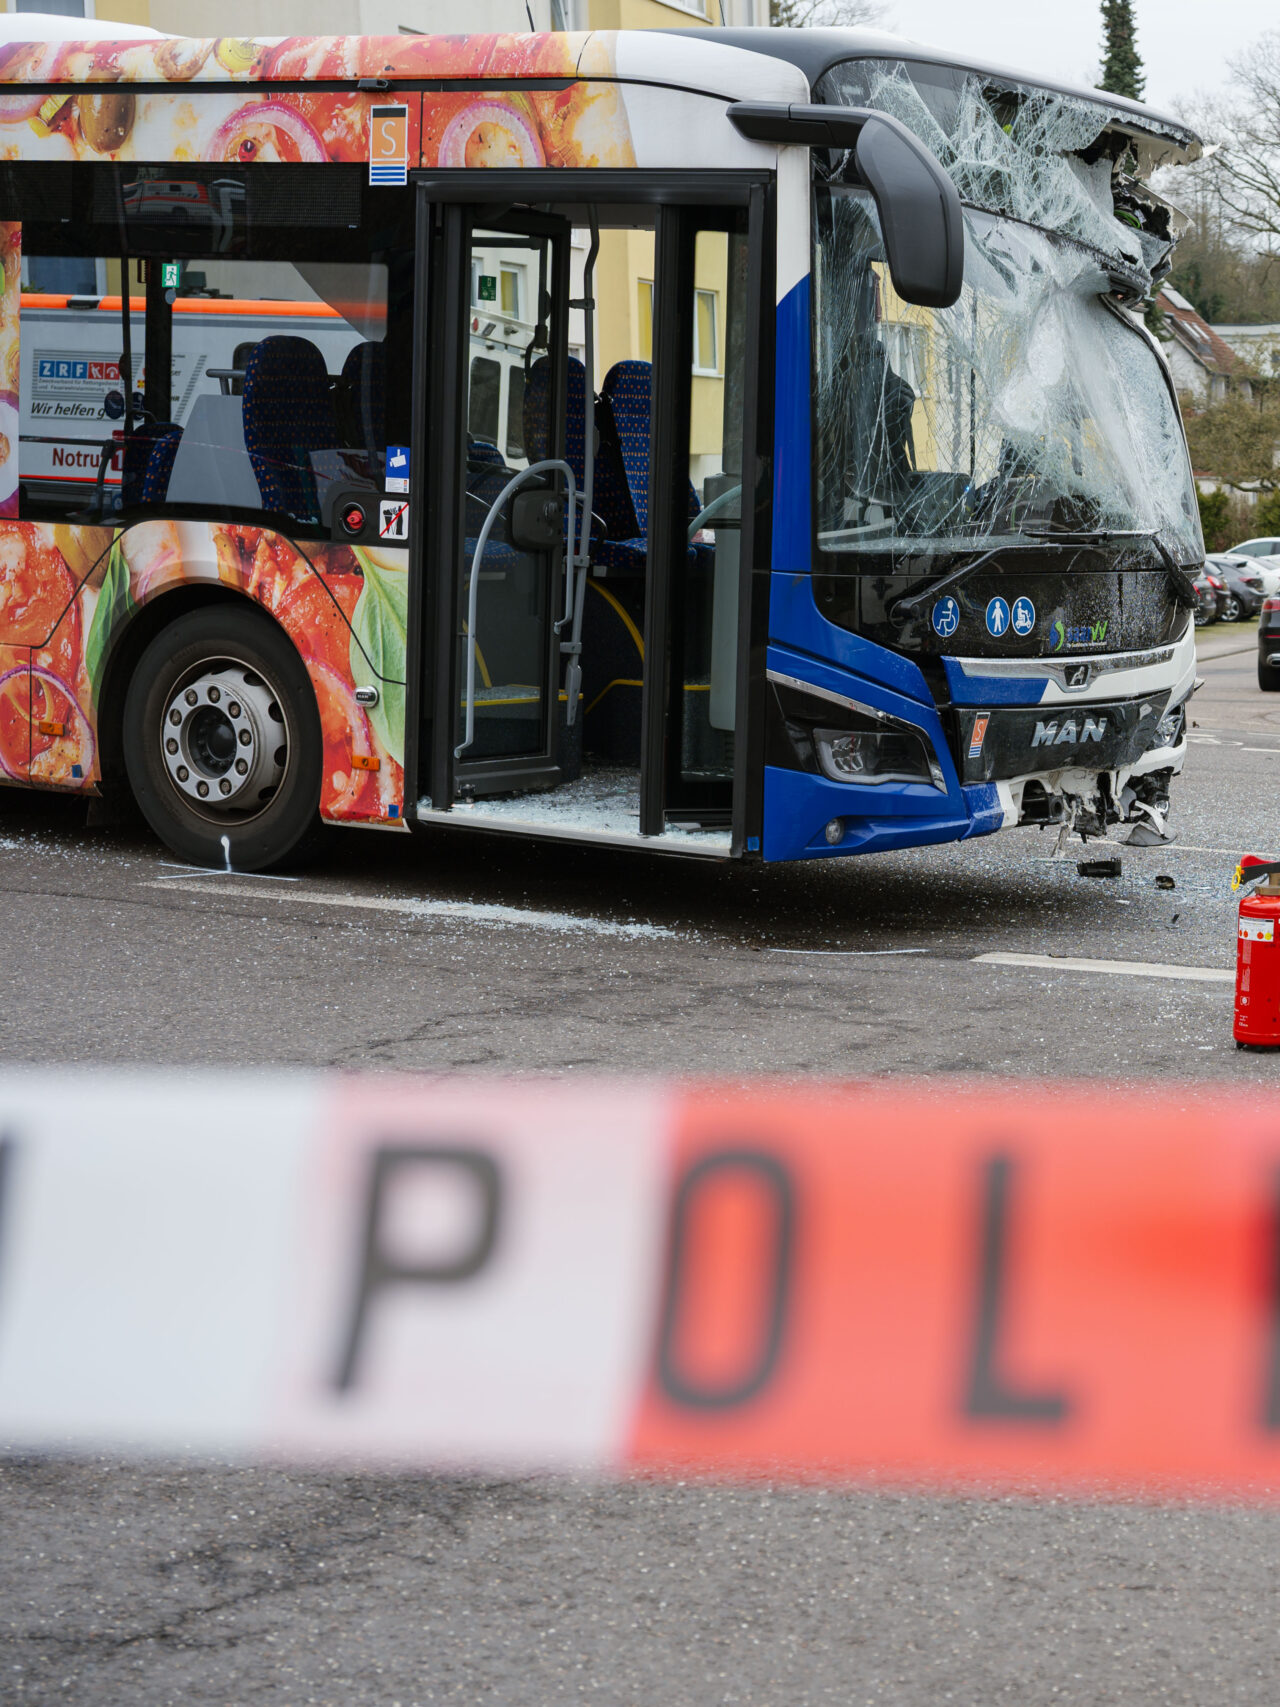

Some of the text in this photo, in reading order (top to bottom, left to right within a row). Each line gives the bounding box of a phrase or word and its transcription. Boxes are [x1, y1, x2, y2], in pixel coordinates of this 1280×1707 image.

[381, 120, 397, 156] S
[31, 402, 53, 415] Wir
[54, 402, 95, 417] helfen
[52, 447, 105, 468] Notru
[974, 720, 984, 742] S
[1031, 718, 1107, 747] MAN
